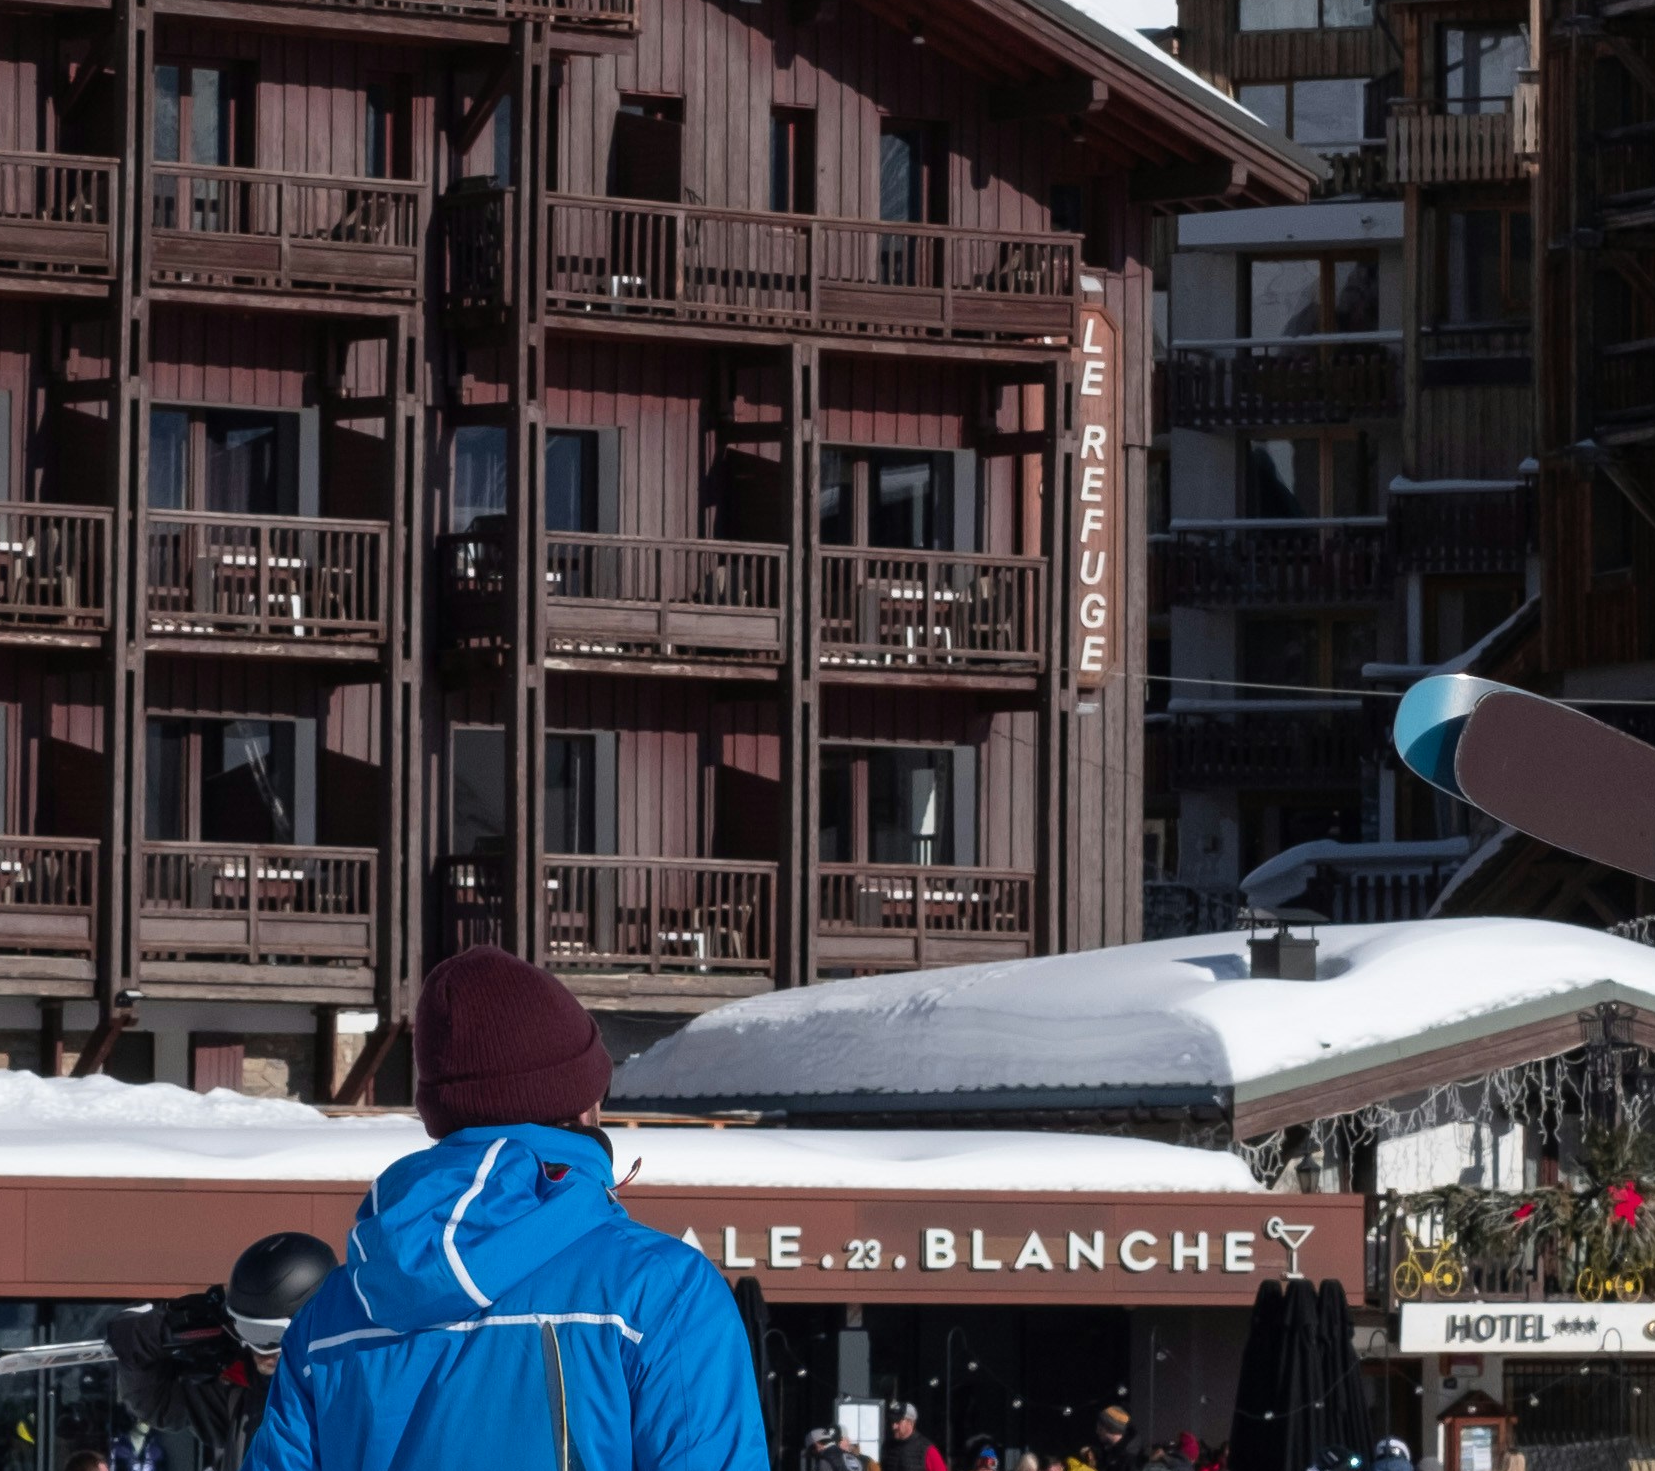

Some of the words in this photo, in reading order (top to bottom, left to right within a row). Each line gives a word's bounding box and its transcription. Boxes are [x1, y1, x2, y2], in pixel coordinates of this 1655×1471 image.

[1080, 318, 1107, 397] LE
[1079, 424, 1108, 672] REFUGE
[922, 1227, 1257, 1272] BLANCHE
[1445, 1314, 1551, 1344] HOTEL
